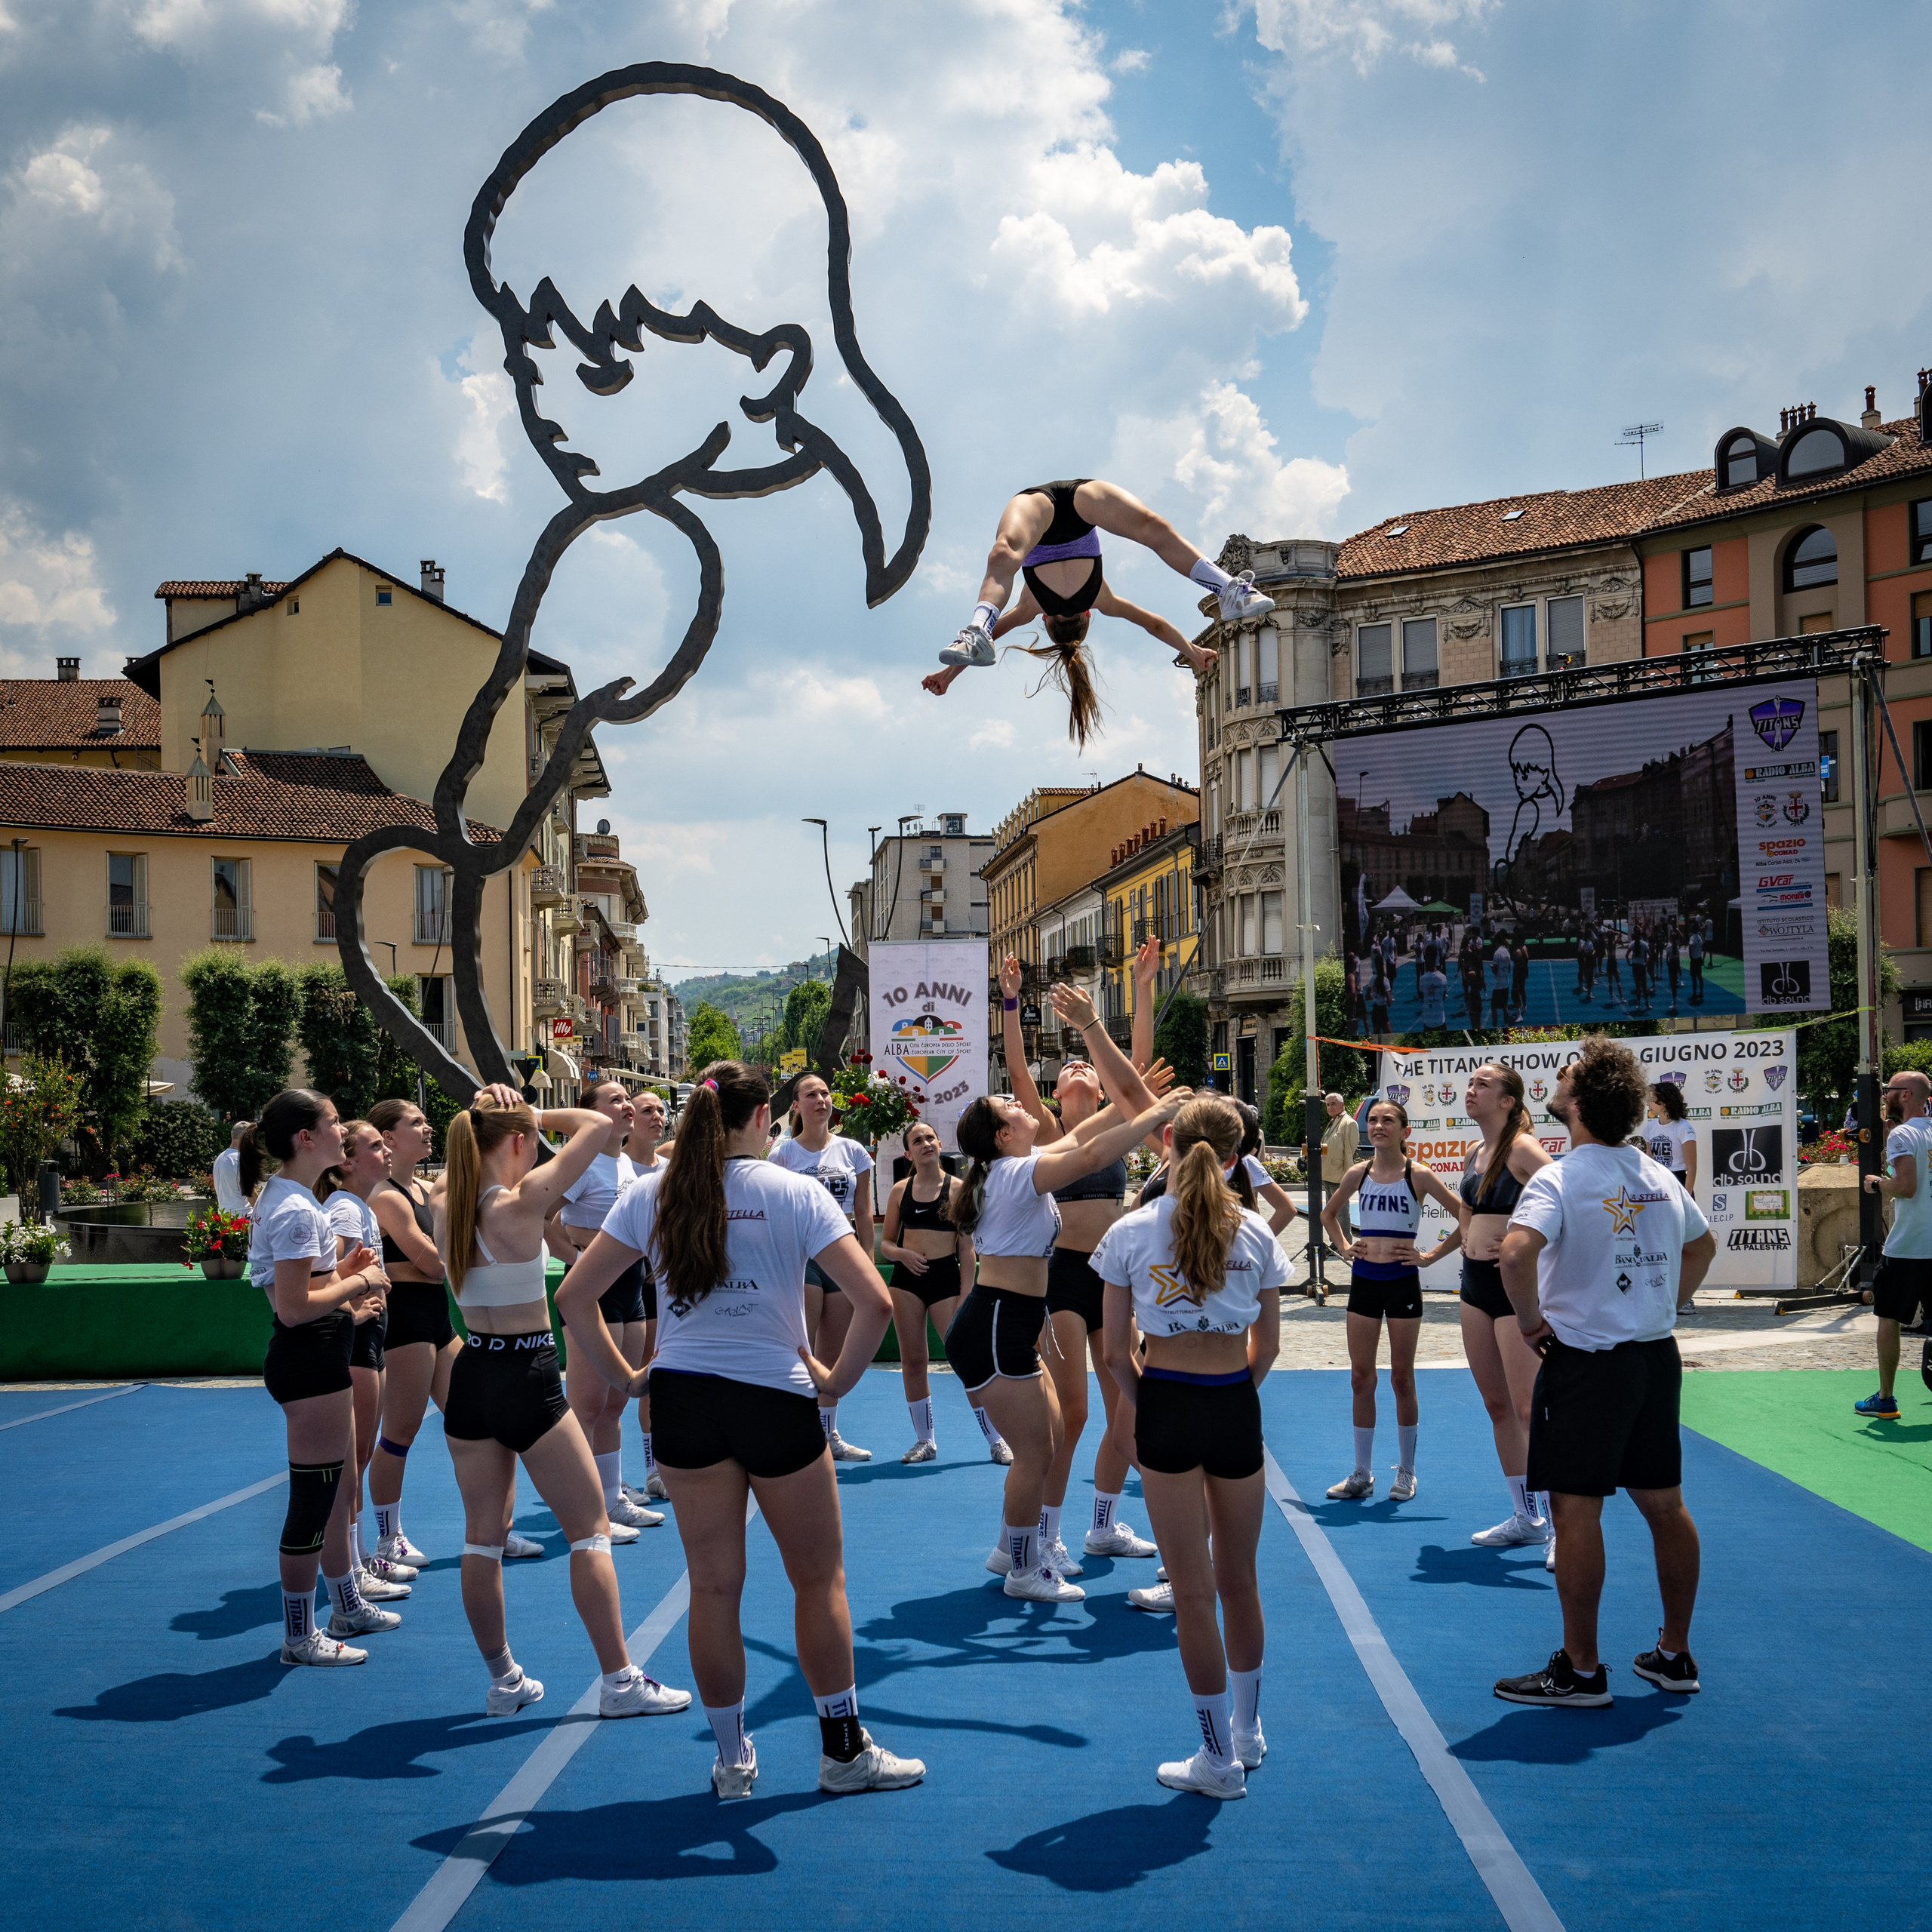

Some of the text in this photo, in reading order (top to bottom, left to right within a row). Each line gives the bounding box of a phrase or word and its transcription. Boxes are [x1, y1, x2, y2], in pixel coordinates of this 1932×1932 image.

[1755, 766, 1786, 777] RADIO
[1789, 762, 1814, 774] ALBA
[1758, 838, 1806, 852] spazio
[1770, 924, 1814, 934] WOJTYLA
[881, 981, 973, 1008] 10 ANNI
[1762, 993, 1810, 1005] db sound
[921, 1001, 935, 1013] di
[555, 1022, 571, 1036] illy
[884, 1044, 909, 1055] ALBA
[1640, 1039, 1784, 1063] GIUGNO 2023
[1393, 1060, 1424, 1077] THE
[1500, 1053, 1561, 1070] SHOW
[934, 1080, 970, 1105] 2023
[1687, 1108, 1710, 1116] ALBA
[1730, 1106, 1759, 1115] RADIO
[1761, 1103, 1781, 1113] ALBA
[1426, 1119, 1439, 1128] ALBA
[1651, 1141, 1672, 1156] WE
[1713, 1170, 1783, 1187] db sound
[1360, 1193, 1410, 1214] TITANS
[1638, 1192, 1669, 1201] STELLA
[1732, 1229, 1790, 1244] TITANS
[514, 1333, 555, 1350] NIKE
[643, 1438, 651, 1468] TITANS
[1526, 1491, 1535, 1518] TANS
[1097, 1500, 1108, 1529] TITANS
[1013, 1536, 1023, 1570] TITANS
[343, 1579, 358, 1612] TITANS
[289, 1598, 303, 1637] TITANS
[1197, 1709, 1216, 1755] TITANS
